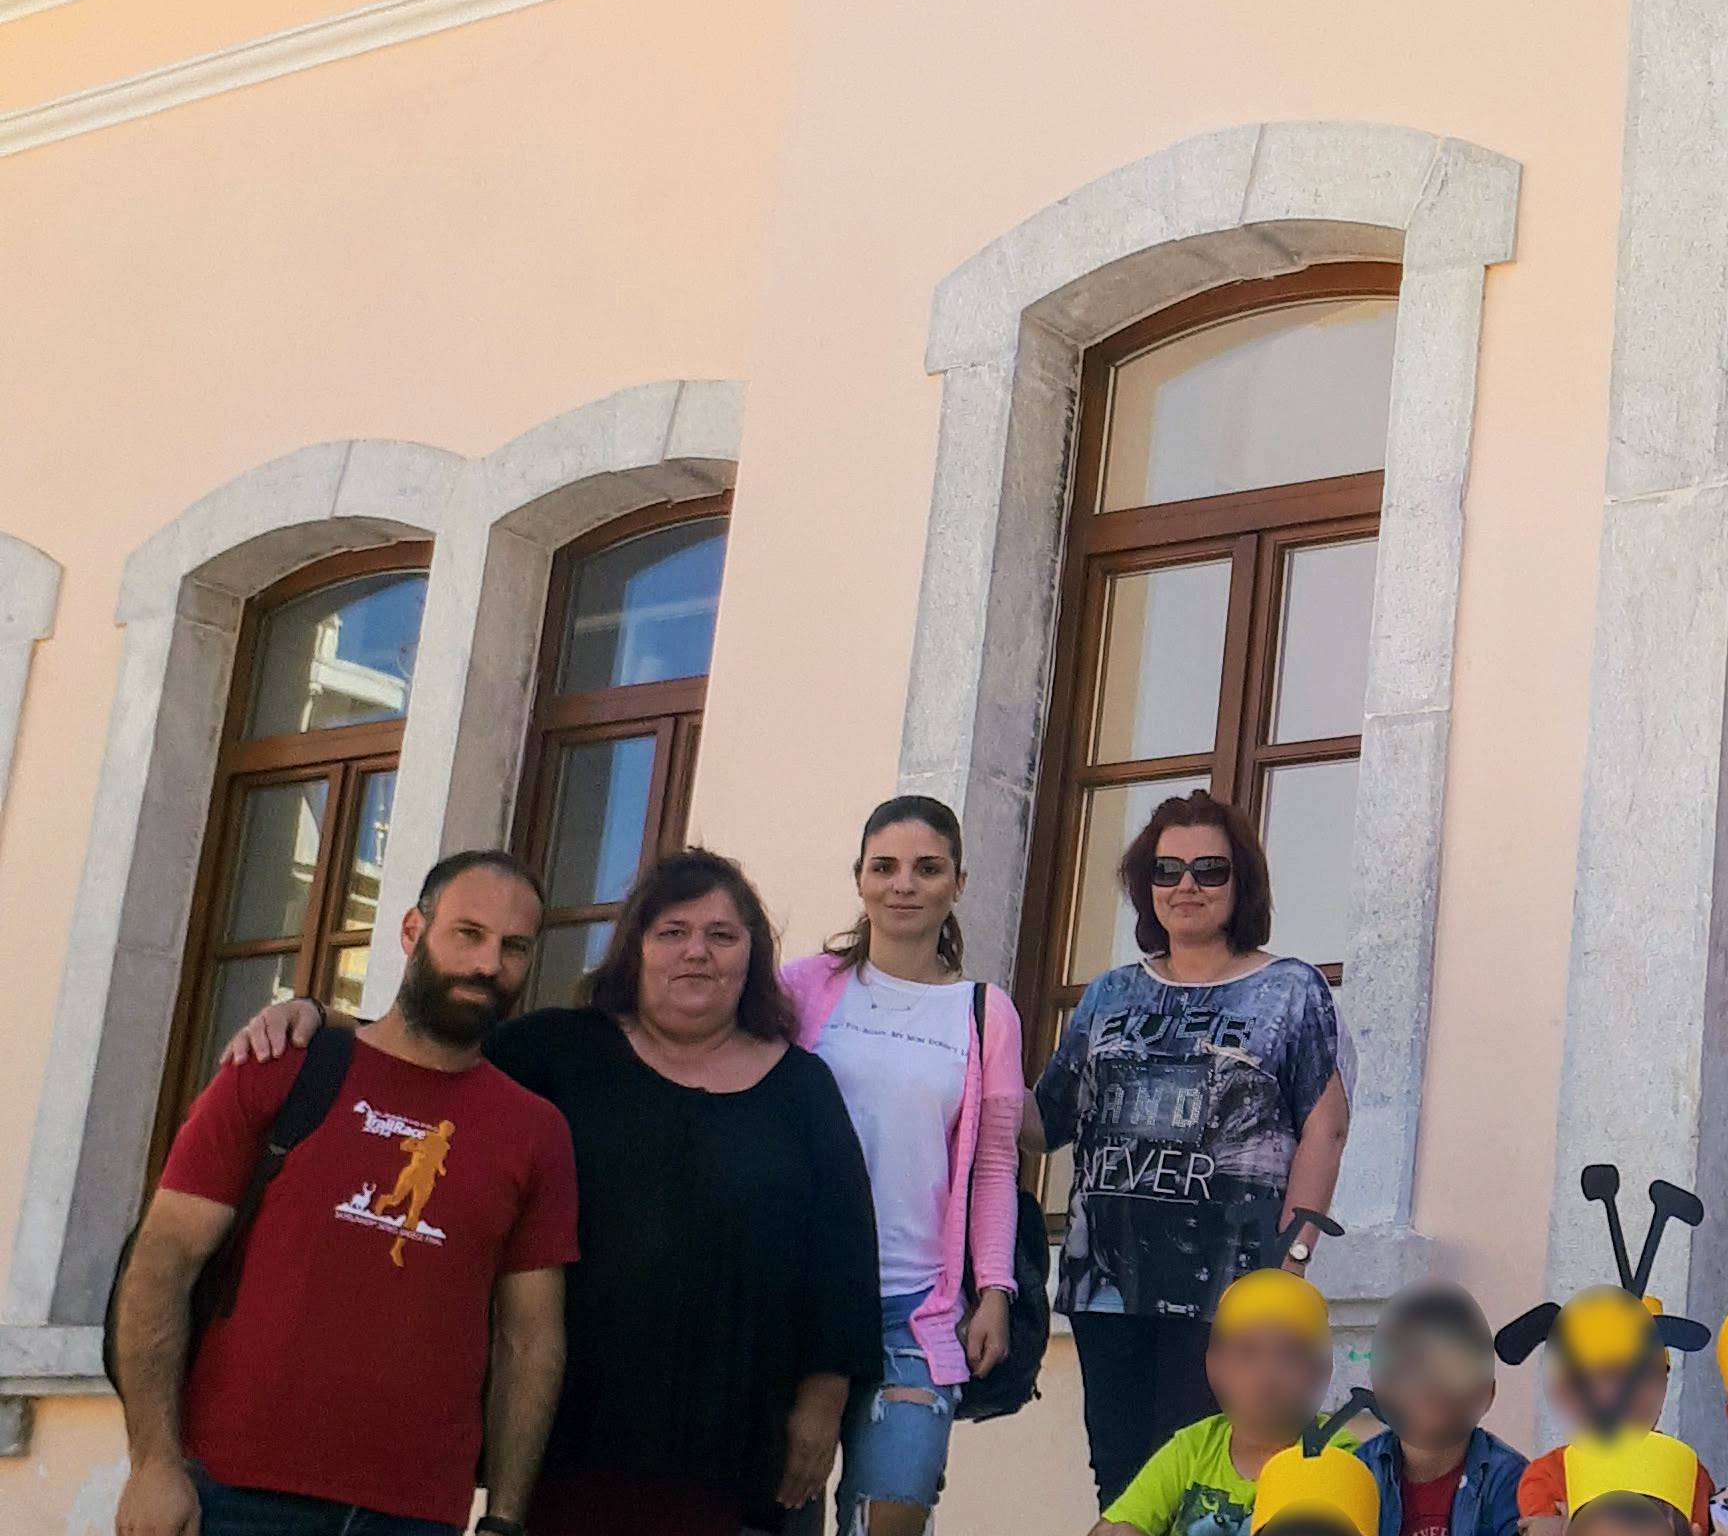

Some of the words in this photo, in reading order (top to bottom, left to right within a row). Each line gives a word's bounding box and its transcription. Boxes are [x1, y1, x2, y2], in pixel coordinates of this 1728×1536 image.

[1095, 1005, 1256, 1050] EVER
[1101, 1084, 1203, 1128] AND
[1083, 1146, 1215, 1200] NEVER
